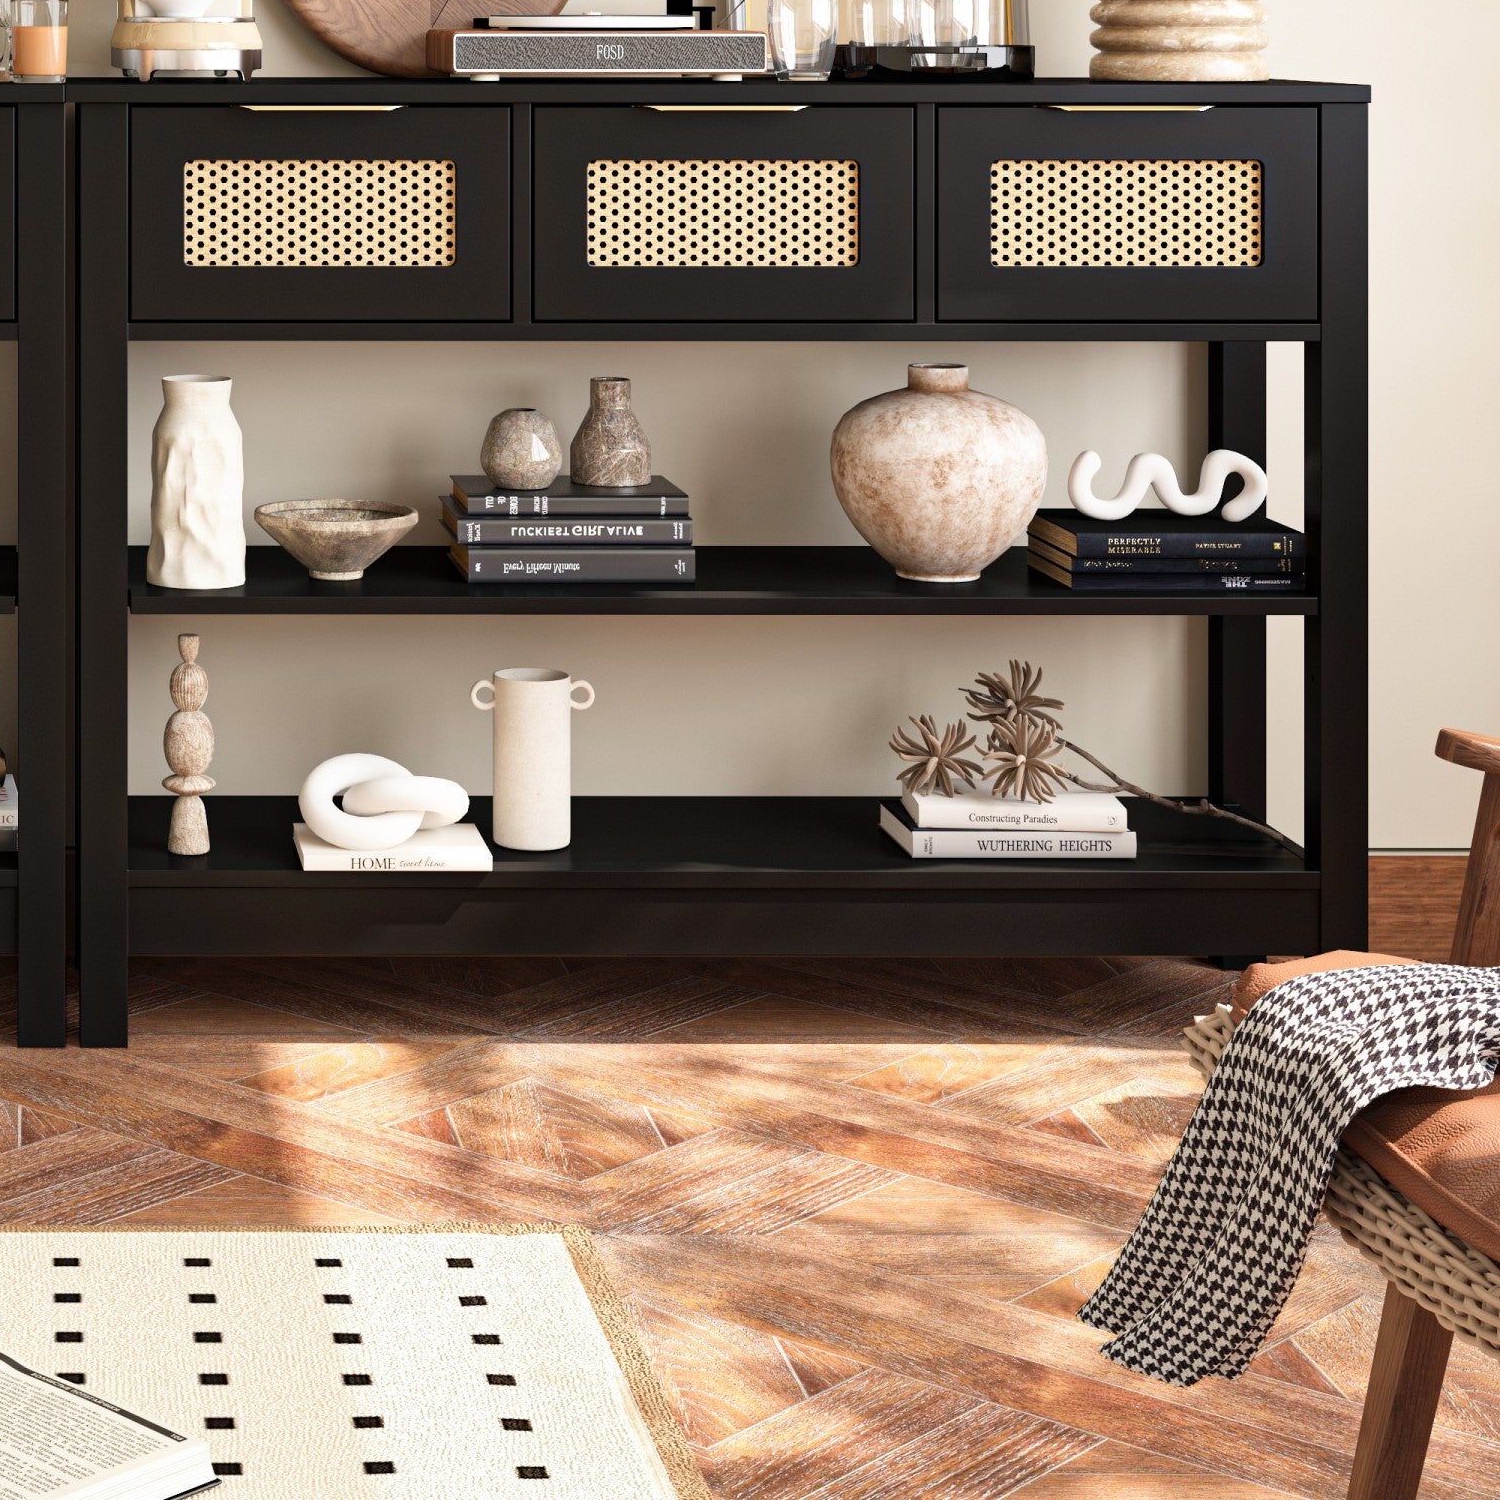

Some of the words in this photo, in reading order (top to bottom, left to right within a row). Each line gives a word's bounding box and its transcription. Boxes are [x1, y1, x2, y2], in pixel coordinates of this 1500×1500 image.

[596, 44, 624, 60] FOSD
[1107, 537, 1162, 546] PERFECTLY
[1107, 546, 1162, 554] MISERABLE
[968, 812, 1022, 826] Constructing
[1023, 813, 1058, 825] Paradies
[977, 839, 1054, 853] WUTHERING
[1059, 839, 1113, 853] HEIGHTS
[350, 857, 396, 870] HOME
